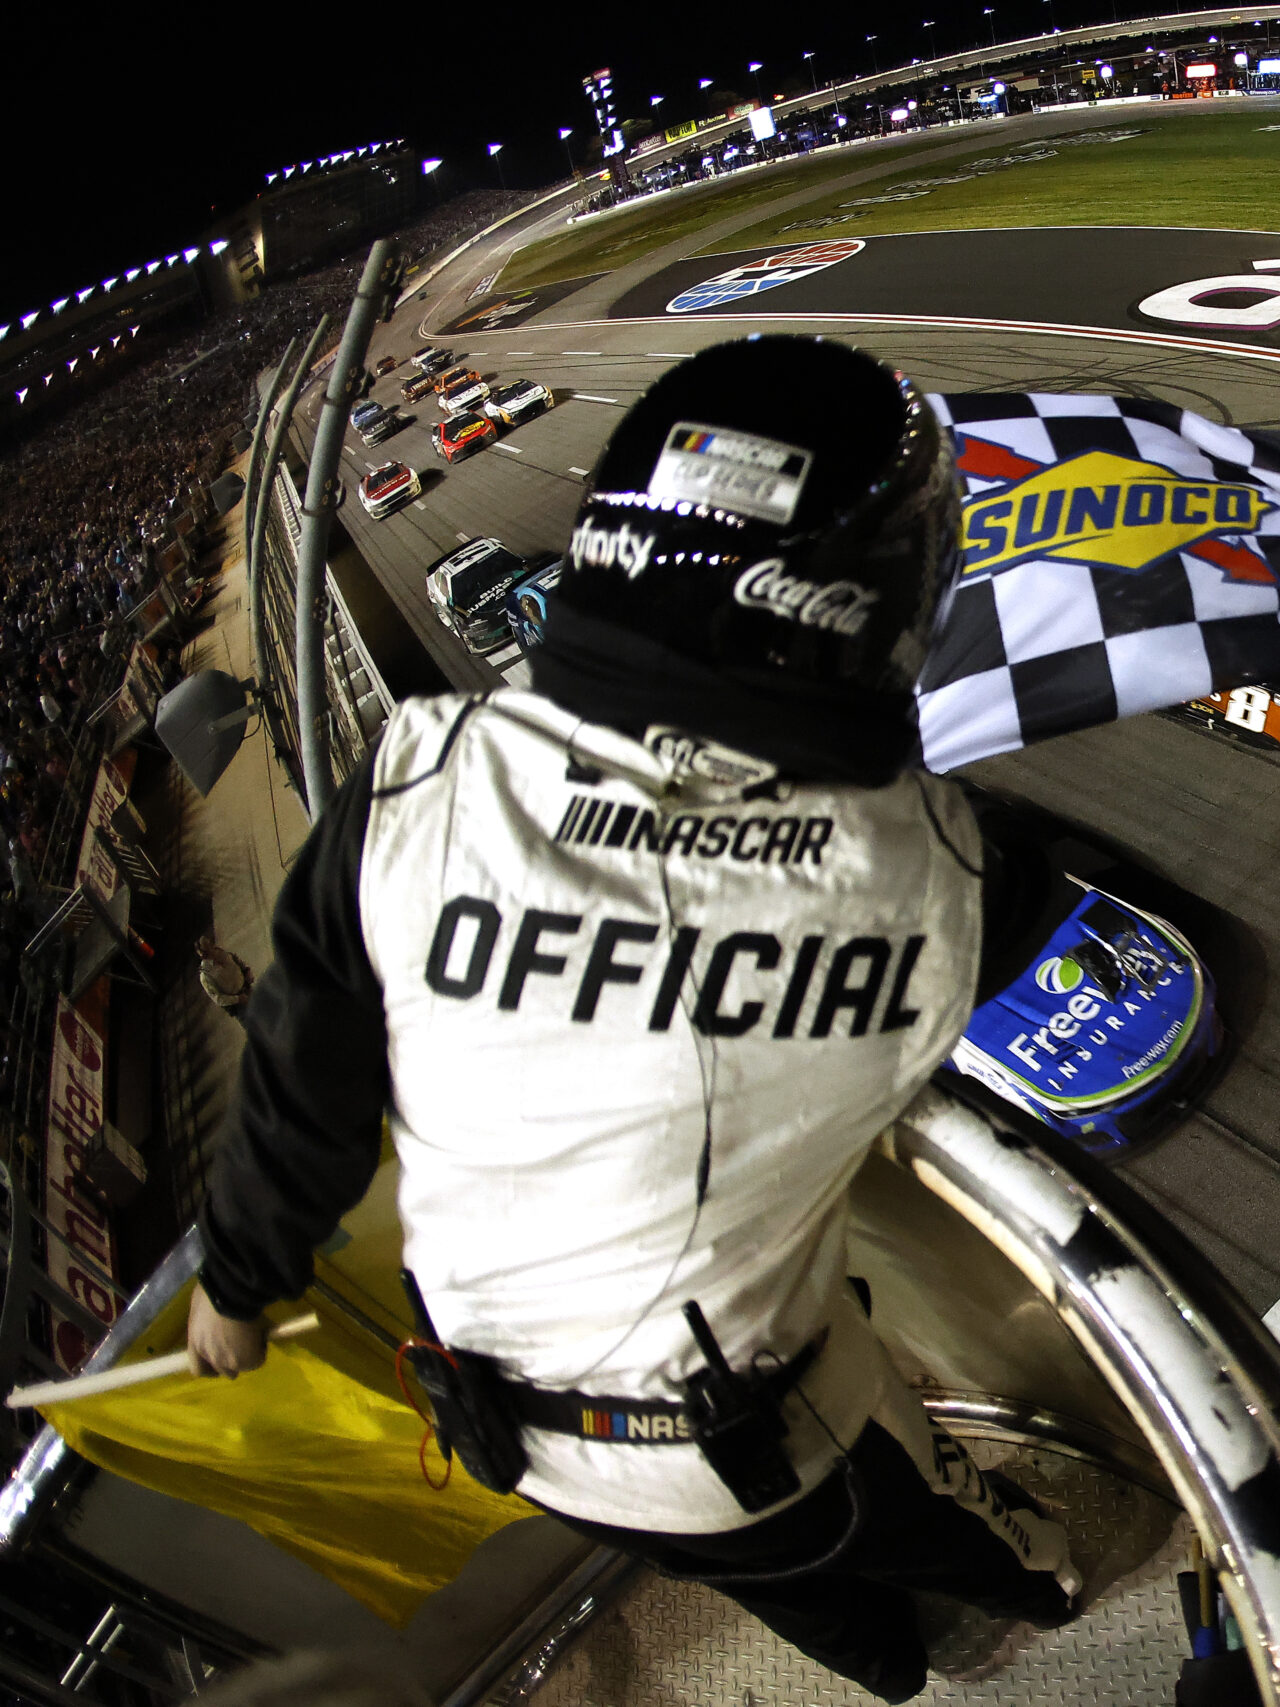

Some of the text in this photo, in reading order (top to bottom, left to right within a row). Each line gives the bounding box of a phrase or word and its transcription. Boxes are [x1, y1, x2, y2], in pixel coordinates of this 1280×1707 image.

[966, 483, 1254, 556] SUNOCO
[480, 577, 513, 599] BUILD
[1225, 686, 1271, 733] 8
[629, 808, 833, 866] NASCAR
[425, 894, 926, 1040] OFFICIAL
[1048, 961, 1185, 1091] INSURANCE
[1121, 1019, 1184, 1079] Freeway.com
